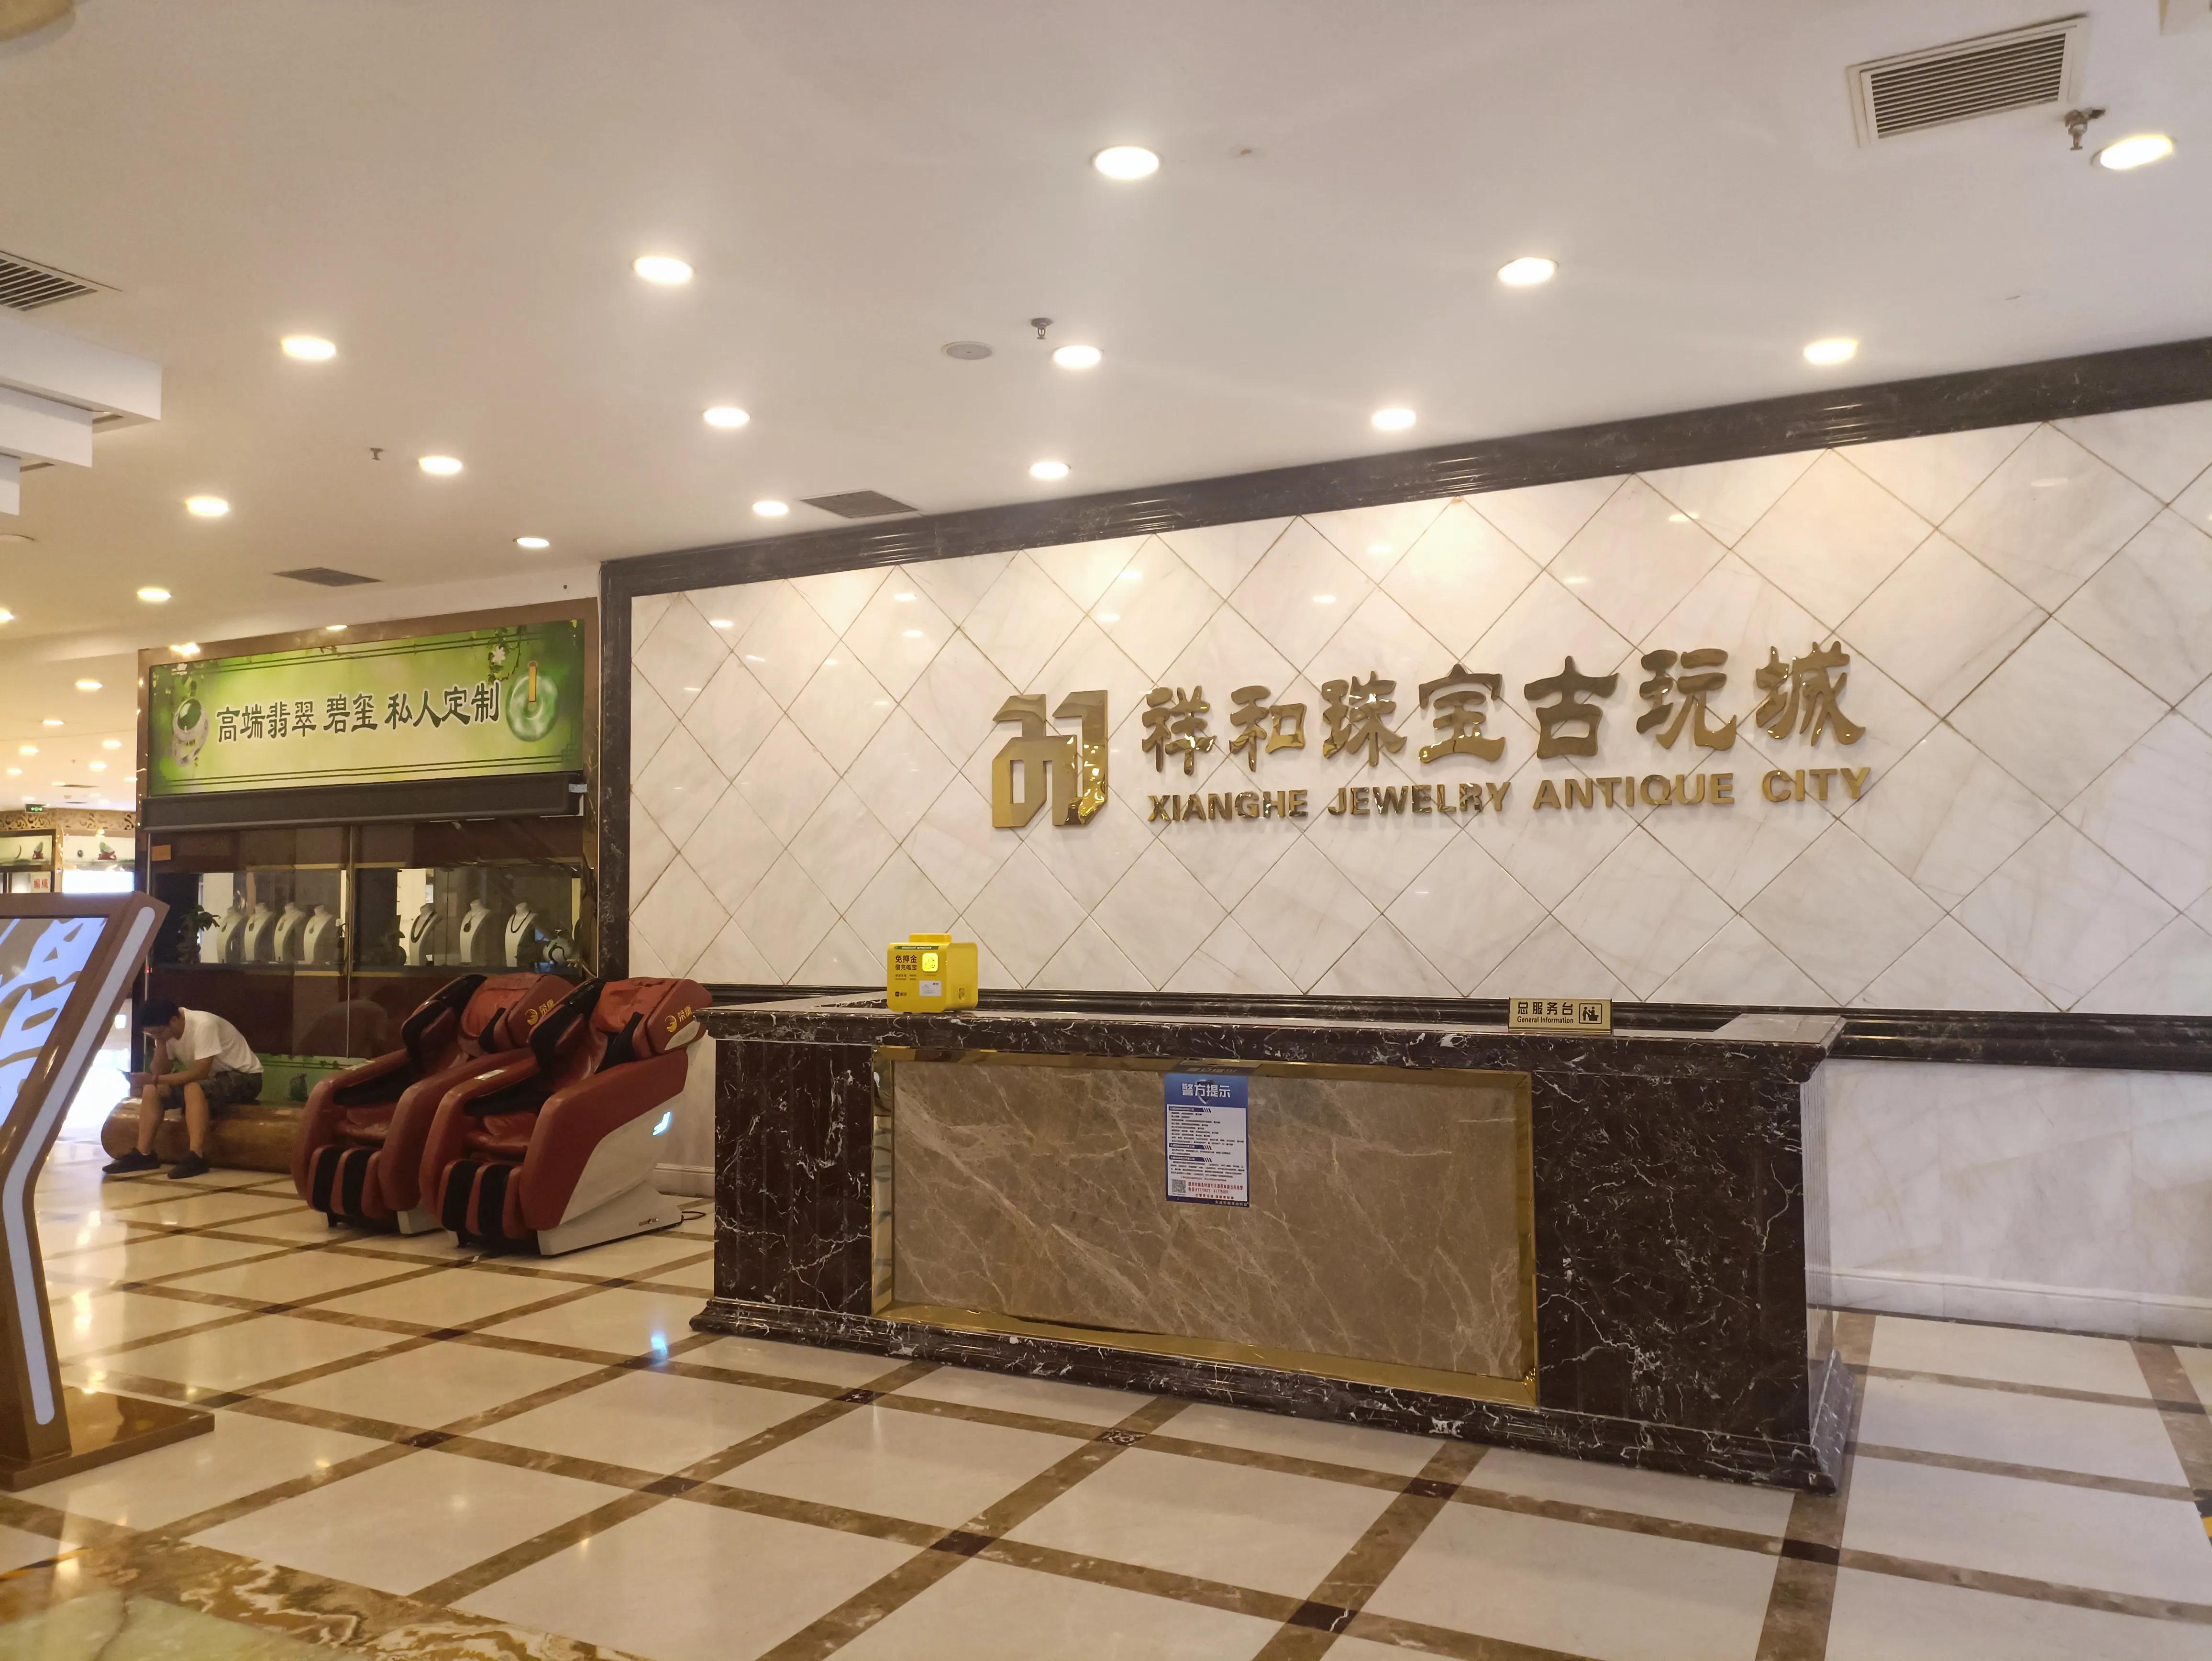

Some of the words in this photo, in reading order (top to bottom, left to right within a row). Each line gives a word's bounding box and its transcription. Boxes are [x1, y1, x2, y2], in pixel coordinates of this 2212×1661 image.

[217, 701, 317, 742] 高端翡翠
[323, 693, 378, 734] 碧玺
[384, 682, 499, 730] 私人定制
[1141, 640, 1866, 775] 祥和珠宝古玩城
[1148, 789, 1309, 821] XIANGHE
[1327, 782, 1511, 816] JEWELRY
[1533, 773, 1734, 809] ANTIQUE
[1762, 766, 1871, 803] CITY
[896, 955, 917, 963] 免押金
[1517, 1001, 1573, 1015] 总服务台
[1182, 1083, 1231, 1098] 警方提示
